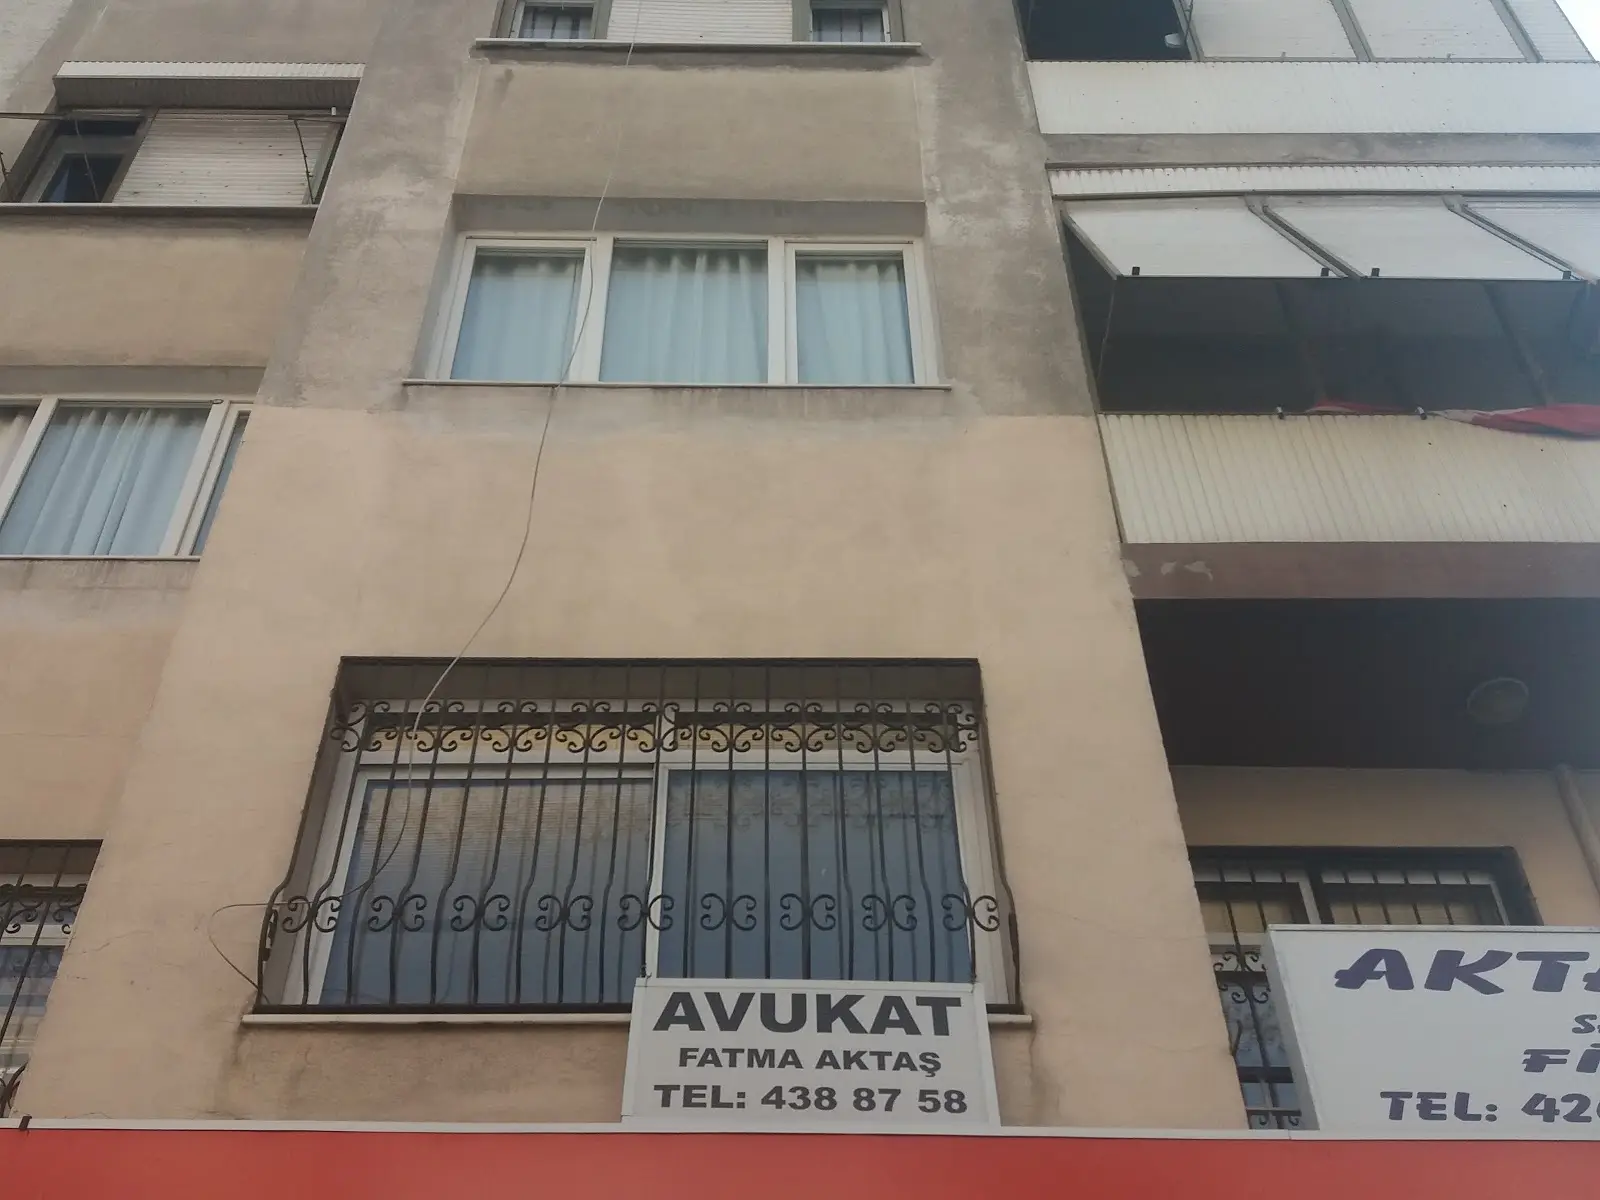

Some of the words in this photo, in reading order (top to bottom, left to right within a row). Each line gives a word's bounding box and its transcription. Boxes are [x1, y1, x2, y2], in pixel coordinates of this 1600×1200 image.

[1333, 948, 1600, 996] AKT
[652, 991, 962, 1037] AVUKAT
[1571, 1014, 1600, 1034] S
[678, 1047, 805, 1070] FATMA
[814, 1049, 942, 1078] AKTAŞ
[653, 1084, 746, 1110] TEL:
[760, 1085, 838, 1111] 438
[852, 1087, 902, 1113] 87
[917, 1088, 968, 1114] 58
[1379, 1091, 1498, 1122] TEL:
[1520, 1092, 1600, 1123] 42
